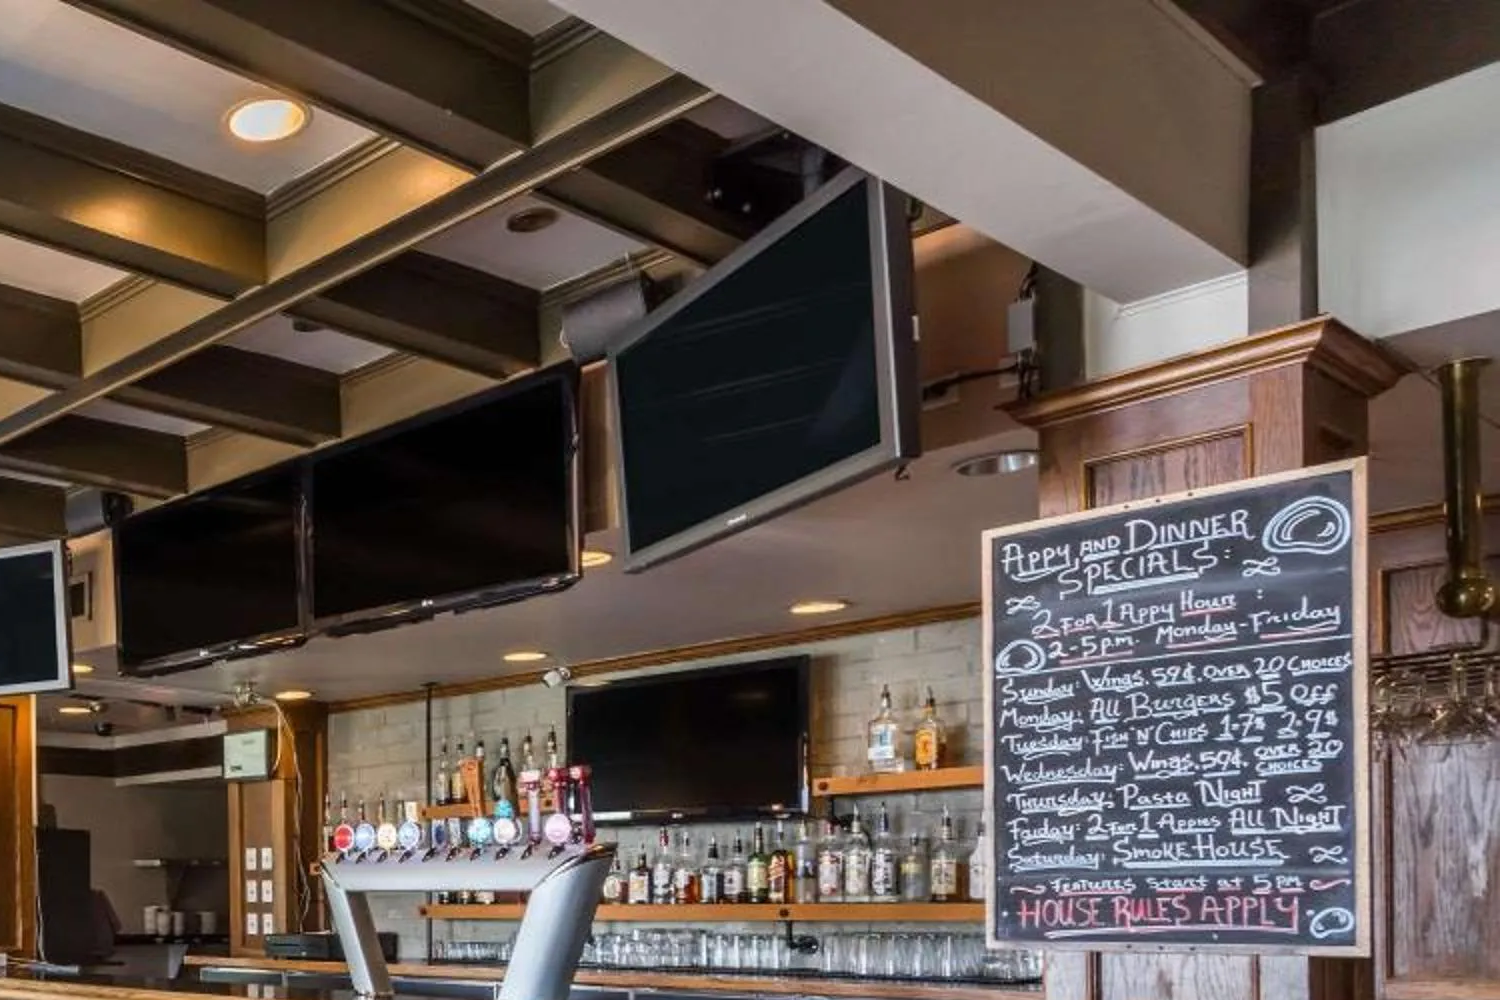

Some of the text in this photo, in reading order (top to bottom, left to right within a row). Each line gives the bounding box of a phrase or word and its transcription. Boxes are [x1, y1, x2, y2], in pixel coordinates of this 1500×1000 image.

[1080, 535, 1120, 556] AND
[1124, 509, 1256, 554] DINNER
[1032, 609, 1060, 635] 2
[1060, 613, 1097, 635] FOR
[1100, 597, 1120, 627] 1
[1253, 656, 1284, 674] 20
[1244, 681, 1283, 706] $5
[1308, 740, 1343, 756] 20
[1116, 784, 1190, 808] Pasta
[1087, 814, 1109, 834] 2
[1138, 812, 1156, 833] 1
[1016, 895, 1299, 932] HOUSE RULES APPLY
